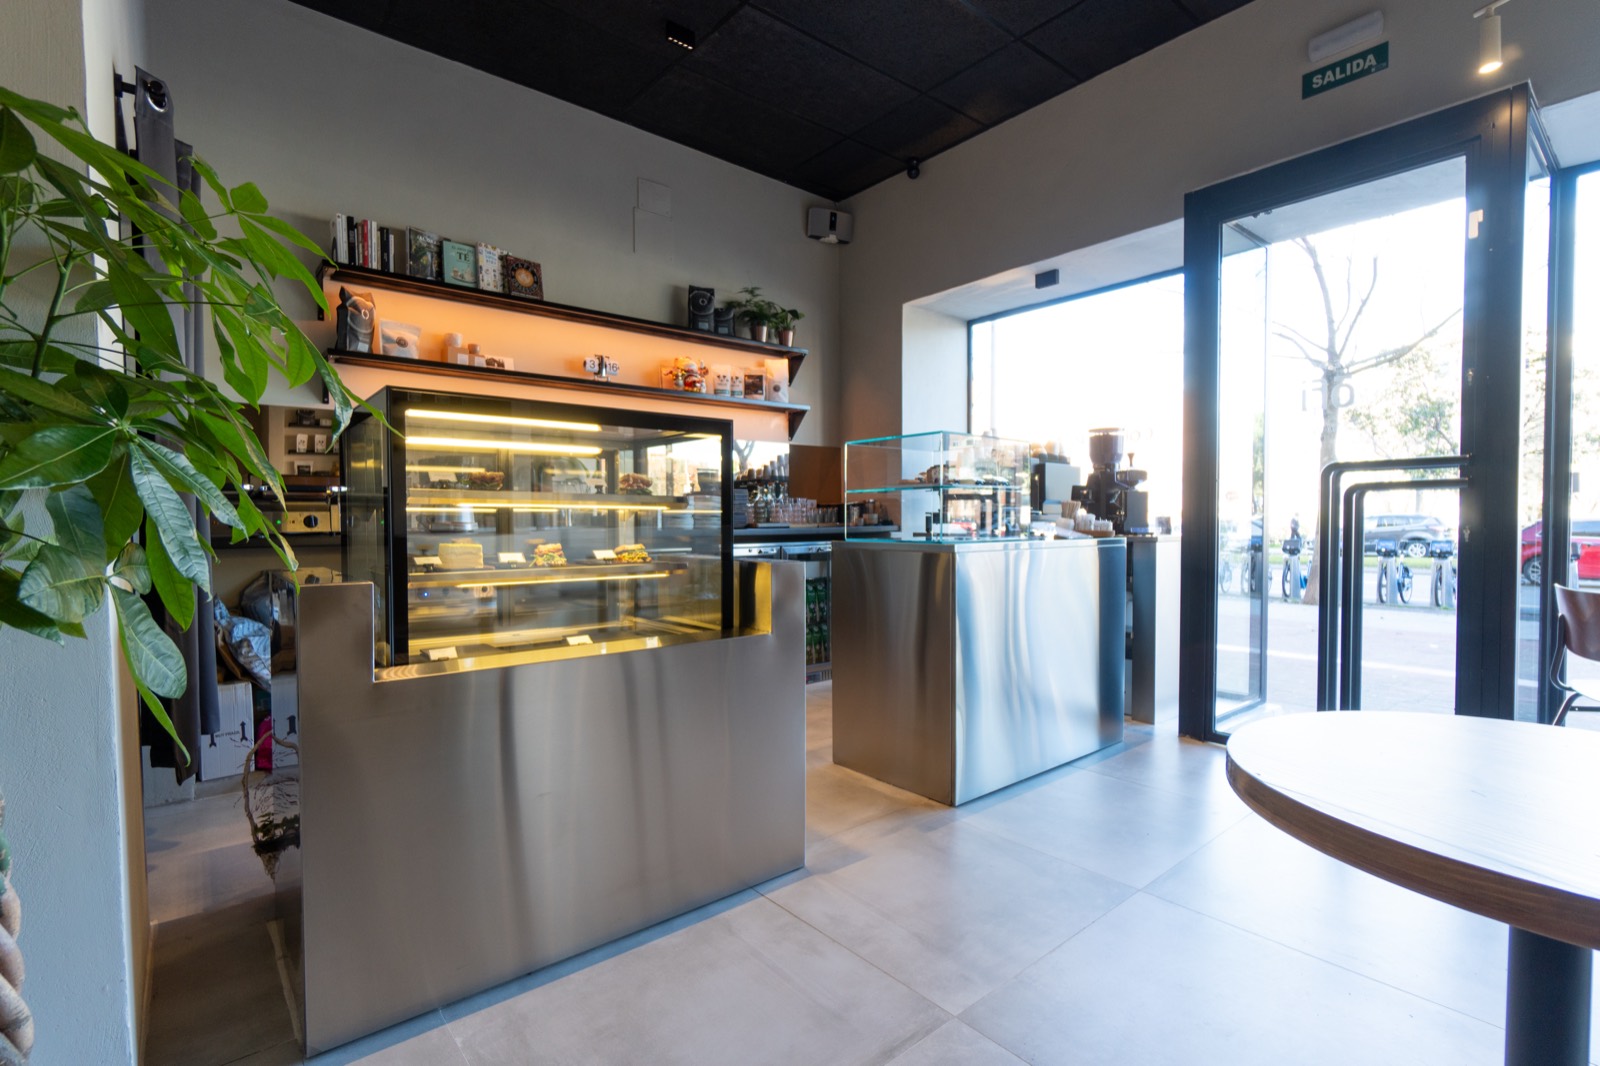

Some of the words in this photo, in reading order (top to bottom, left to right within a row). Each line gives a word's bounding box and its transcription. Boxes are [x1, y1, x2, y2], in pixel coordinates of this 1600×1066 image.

[1312, 53, 1377, 89] SALIDA
[589, 359, 596, 370] 3
[607, 362, 618, 373] 16
